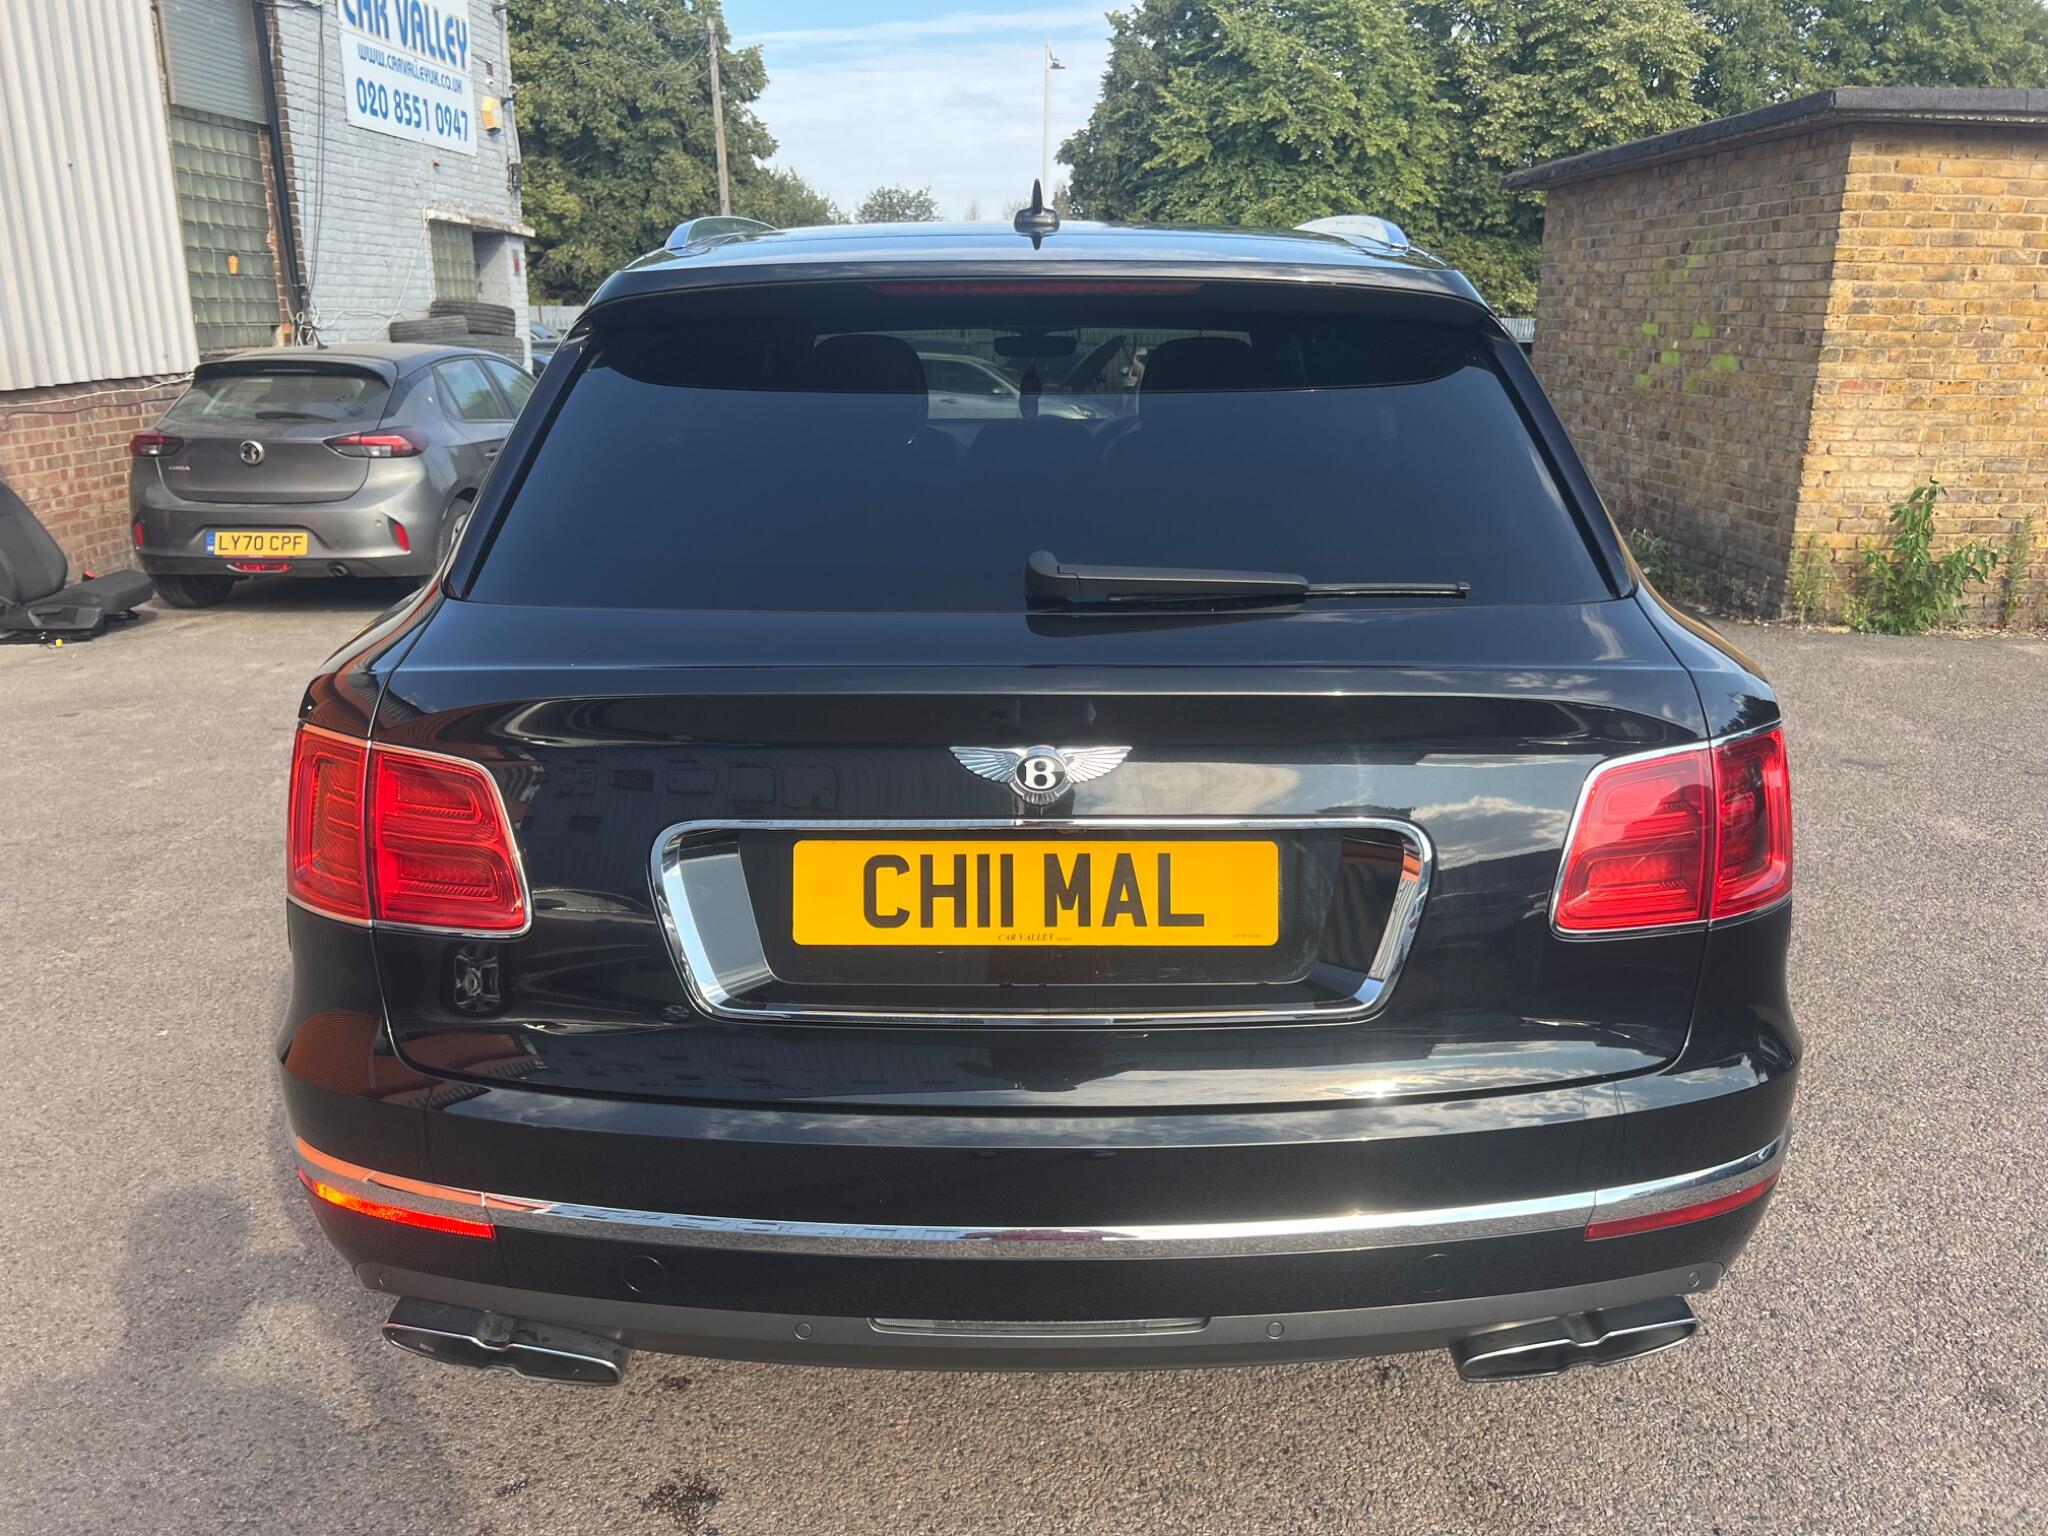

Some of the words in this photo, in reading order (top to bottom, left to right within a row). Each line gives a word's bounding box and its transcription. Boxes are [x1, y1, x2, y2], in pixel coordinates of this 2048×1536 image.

[342, 0, 391, 42] CAR
[396, 0, 468, 70] VALLEY
[356, 77, 389, 120] 020
[394, 89, 430, 131] 8551
[435, 102, 468, 141] 0947
[219, 535, 264, 551] LY70
[269, 535, 303, 551] CPF
[1044, 853, 1204, 927] MAL
